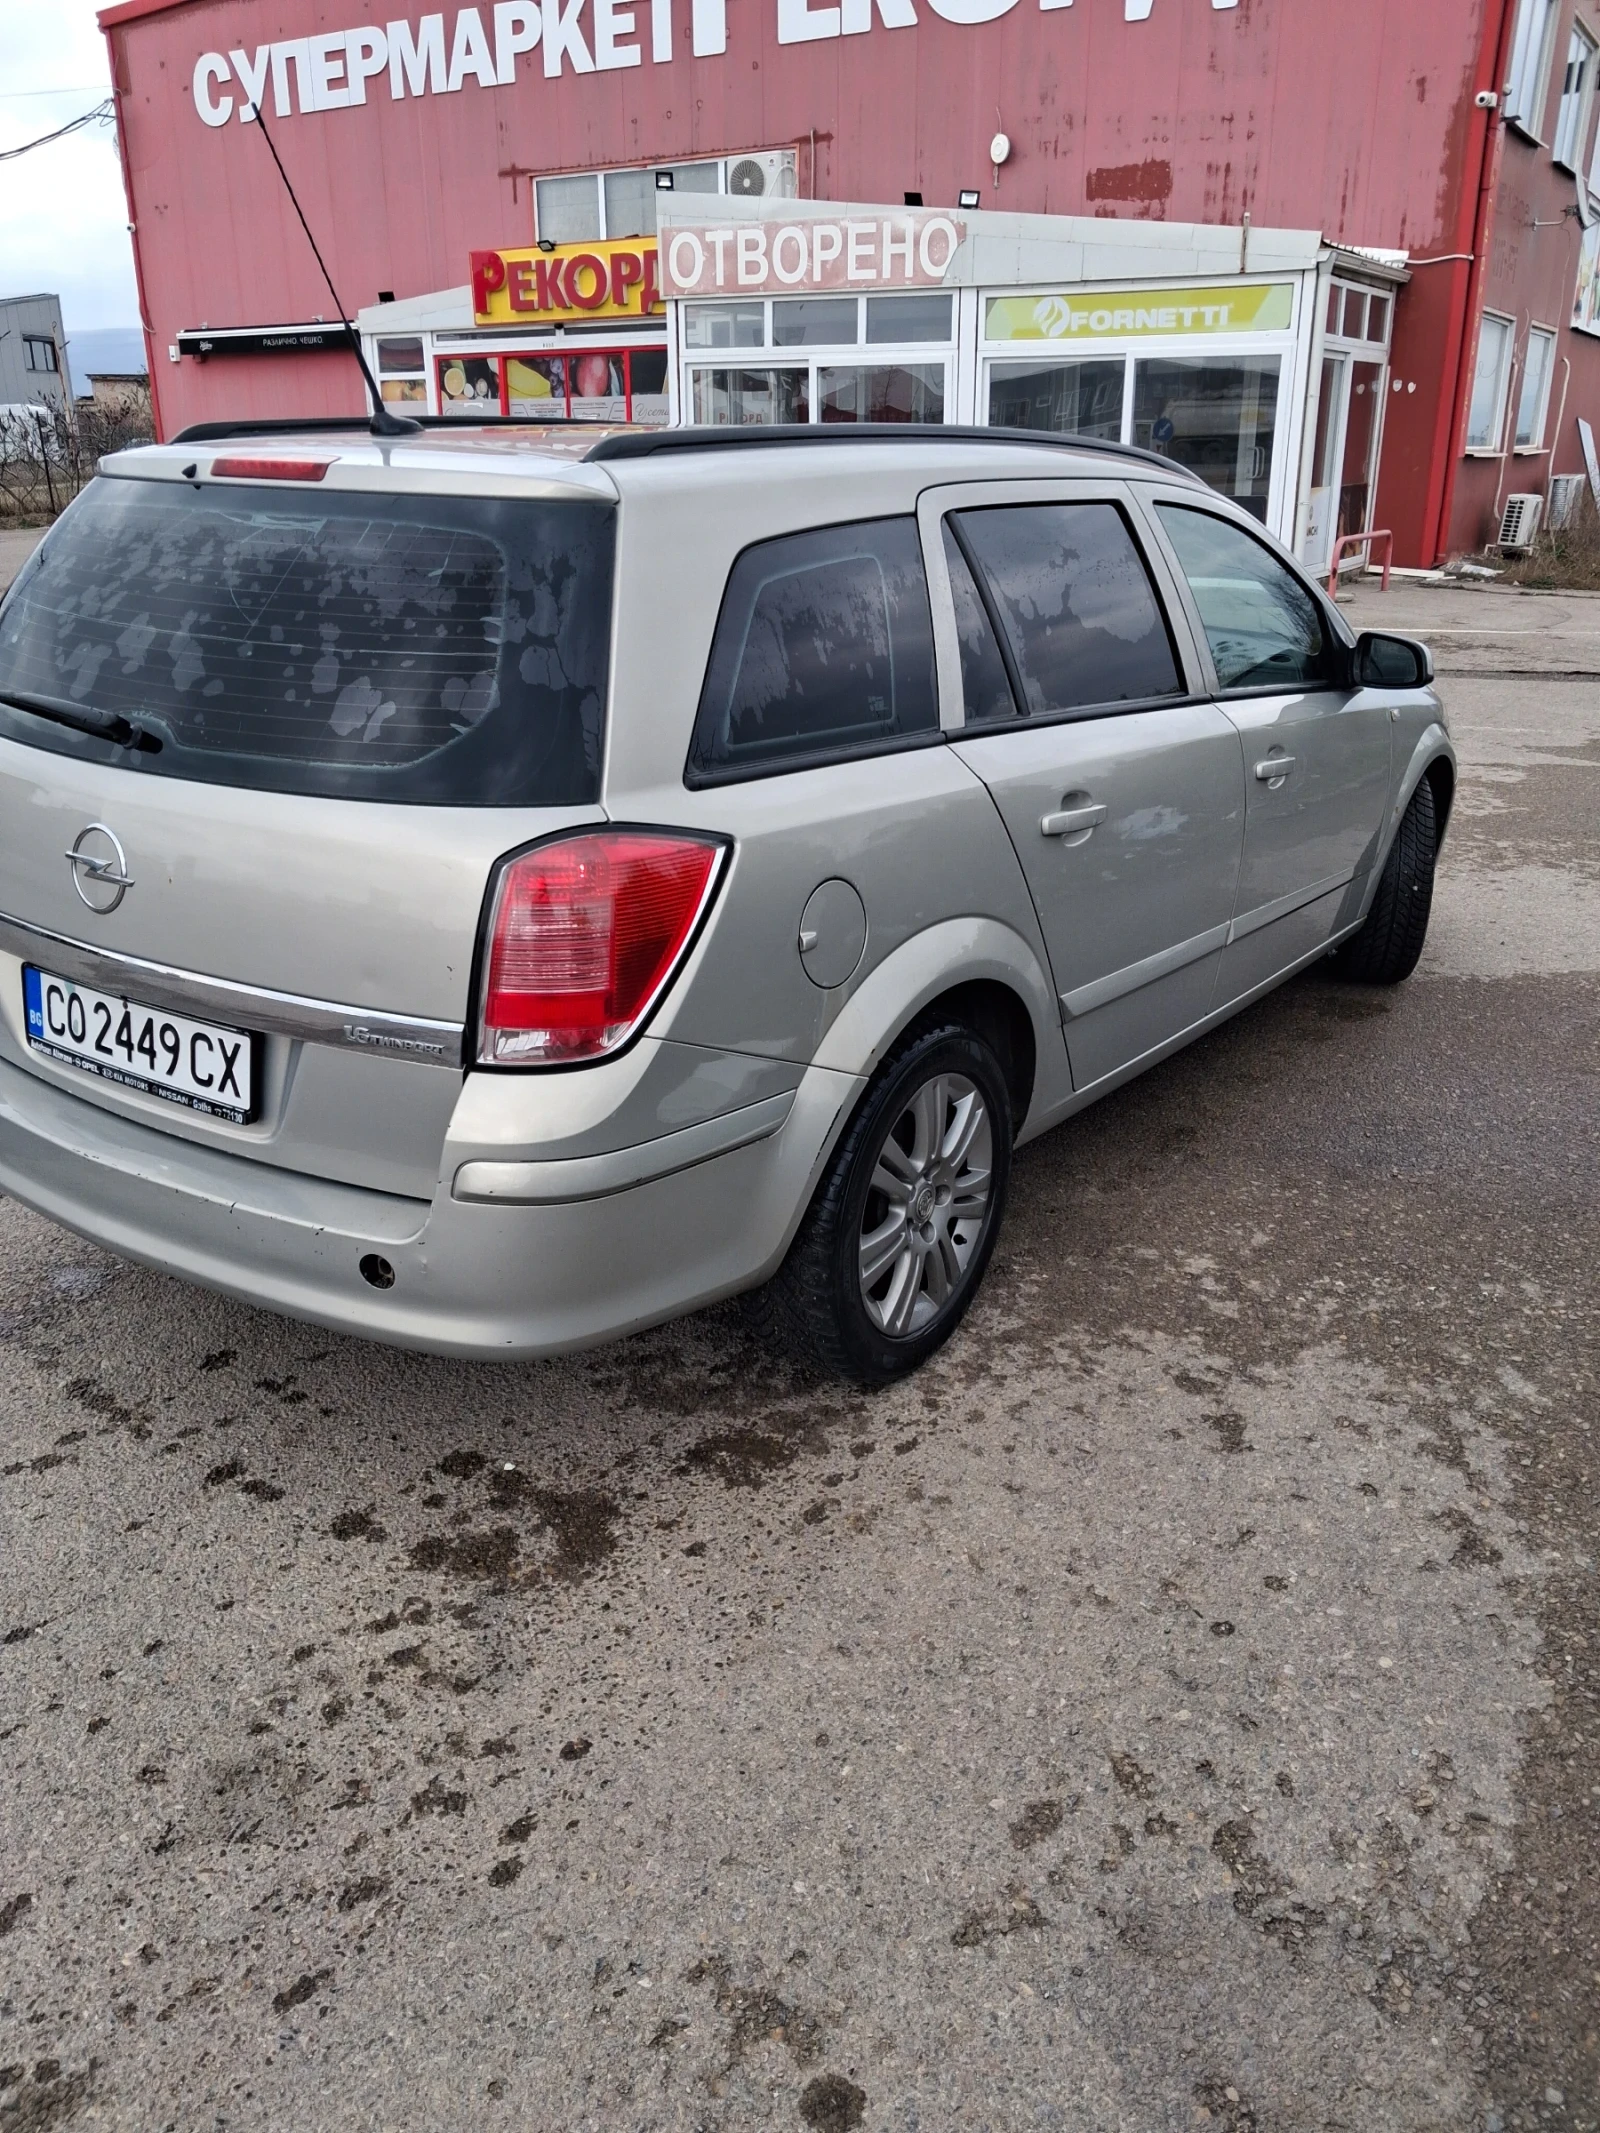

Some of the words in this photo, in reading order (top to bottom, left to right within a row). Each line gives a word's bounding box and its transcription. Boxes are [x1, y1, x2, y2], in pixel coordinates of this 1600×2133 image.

[669, 217, 958, 289] ОТВОРЕНО
[1070, 304, 1229, 333] FORNETTI
[29, 1008, 42, 1027] BG
[46, 984, 86, 1044] CO
[93, 1001, 181, 1076] 2449
[190, 1031, 241, 1099] CX
[368, 1034, 446, 1055] TWINPORT
[81, 1060, 99, 1074] OPEL
[113, 1072, 124, 1083] KIA
[124, 1076, 149, 1091] MOTORS
[158, 1088, 189, 1105] NISSAN
[192, 1098, 212, 1114] Gotha
